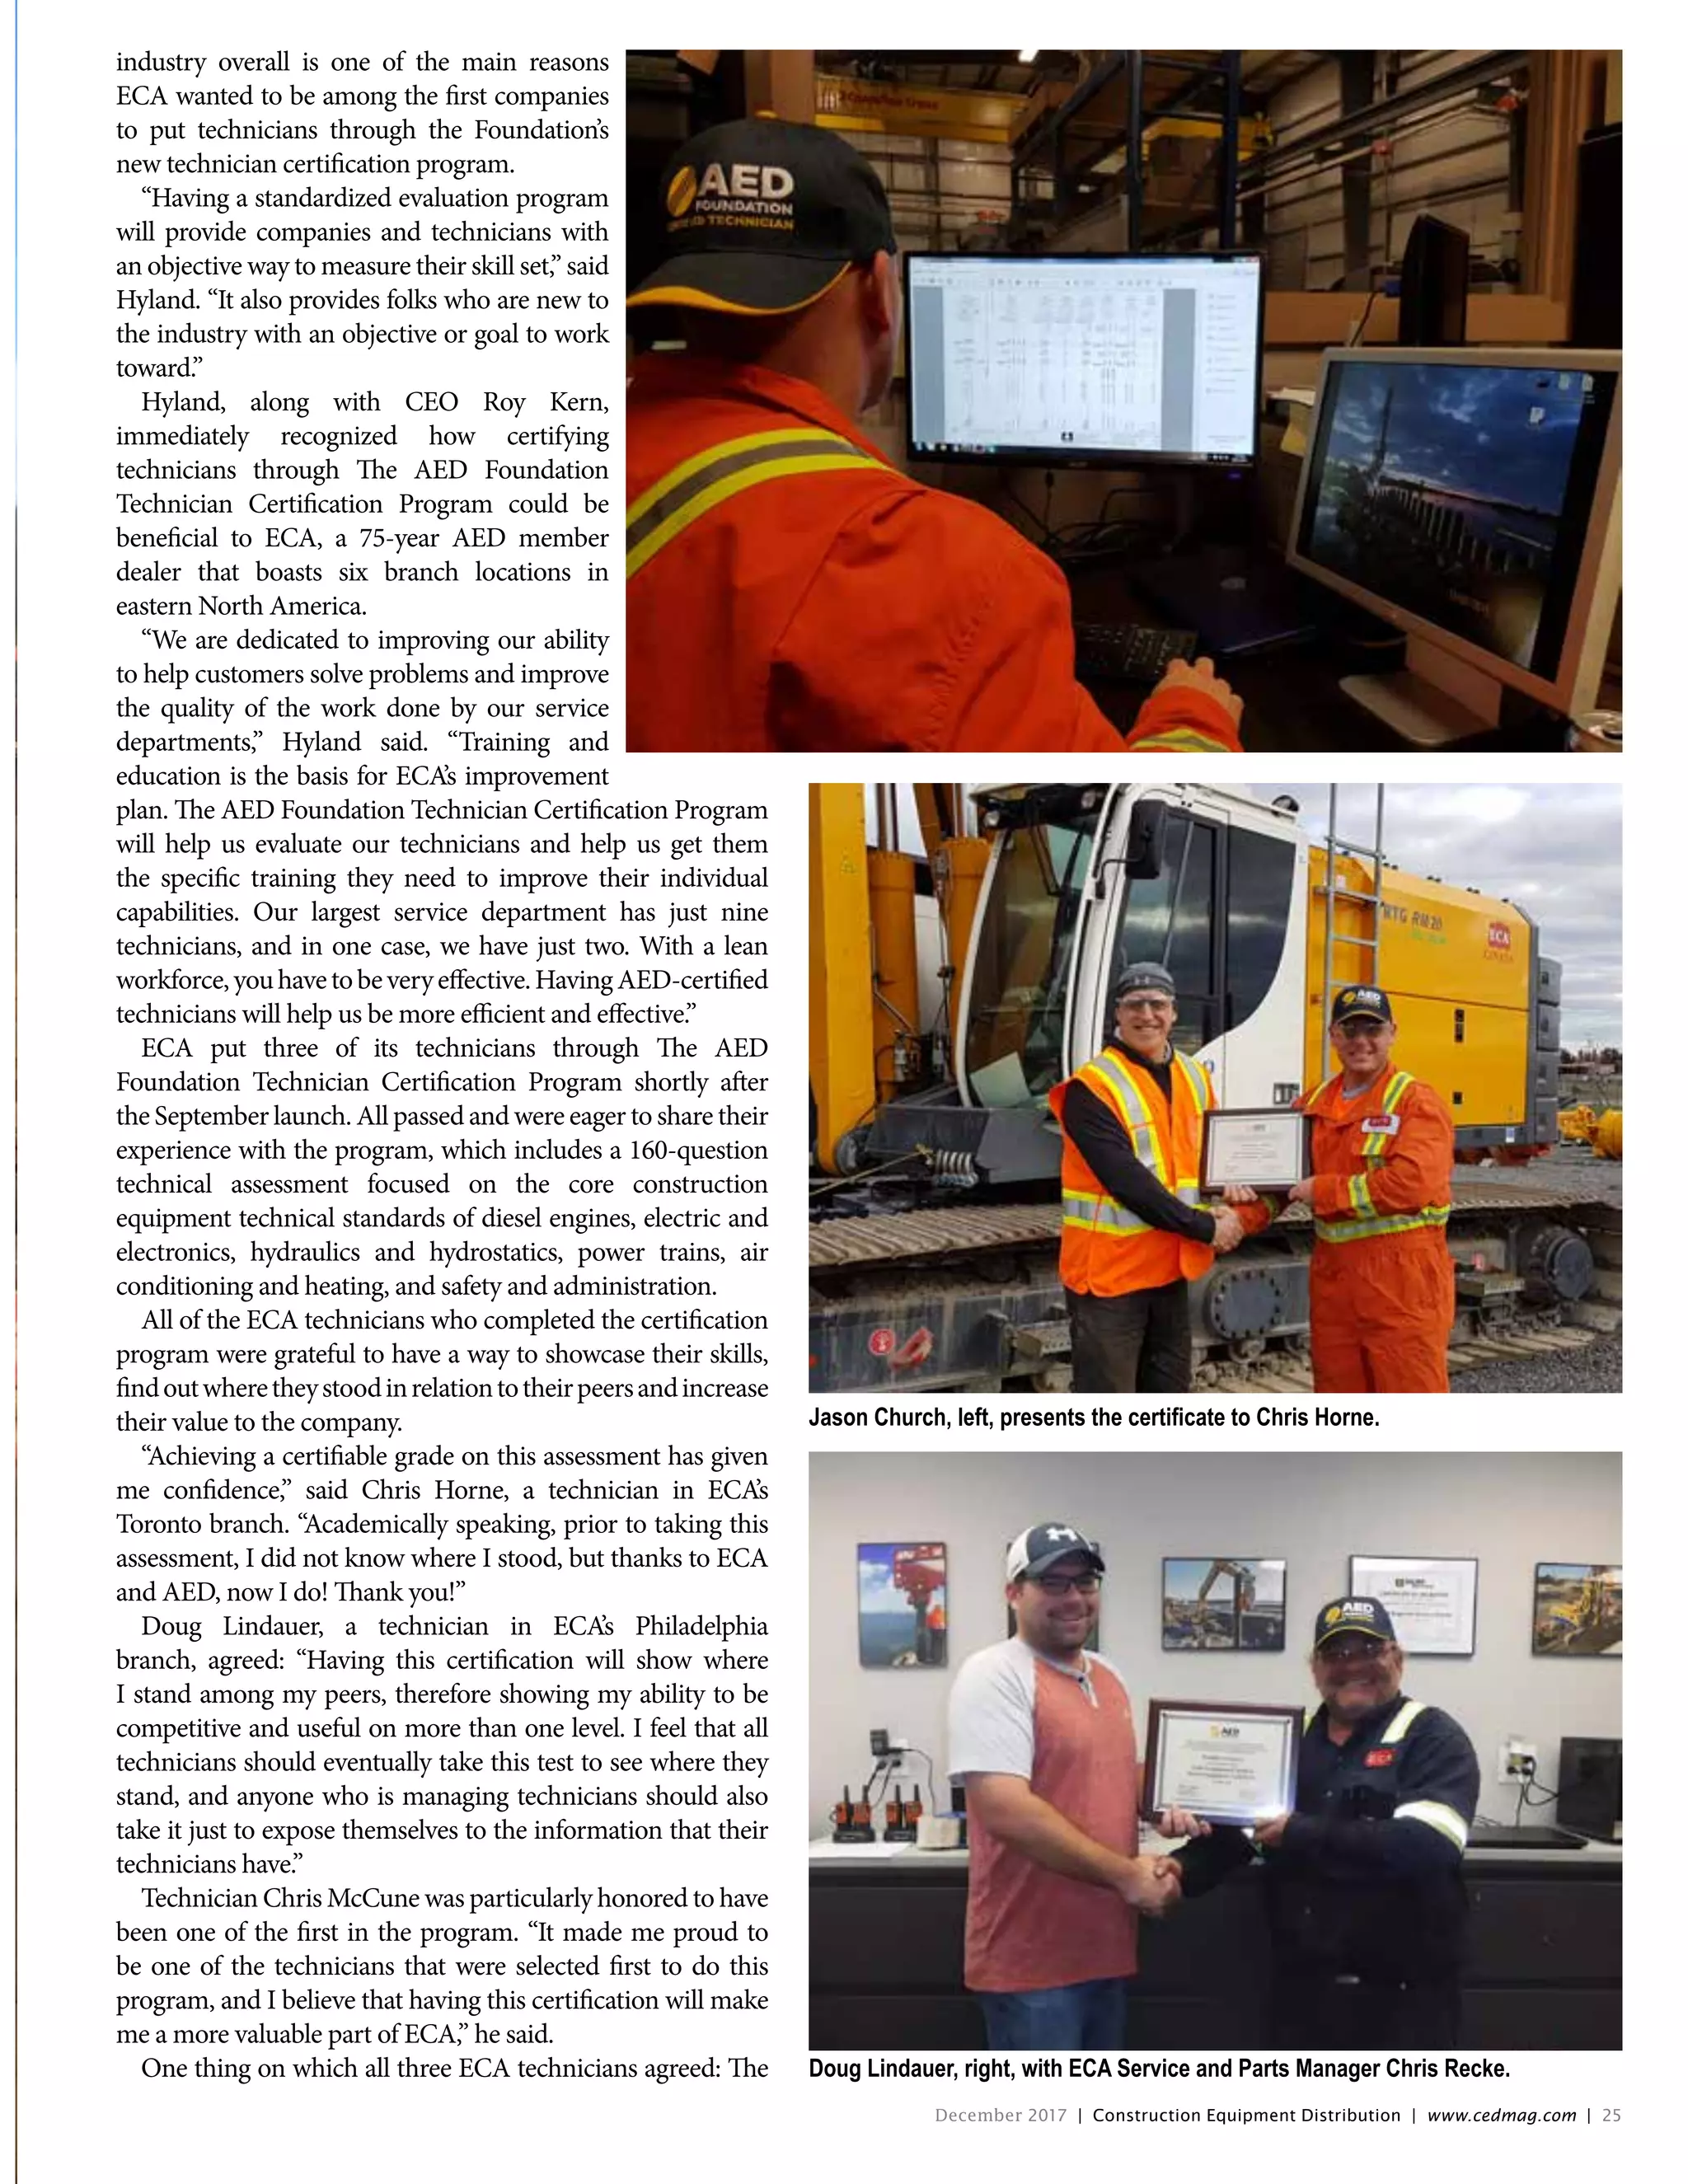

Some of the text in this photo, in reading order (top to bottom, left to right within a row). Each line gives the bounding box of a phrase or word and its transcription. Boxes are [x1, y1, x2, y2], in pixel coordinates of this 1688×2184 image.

[116, 49, 609, 78] industry overall is one of the main reasons
[697, 163, 795, 199] AED
[696, 199, 794, 215] FOUNDATION
[707, 214, 795, 231] TECHNICIAN
[141, 390, 609, 419] Hyland, along with CEO Roy Kern,
[115, 492, 609, 521] Technician Certification Program could be
[115, 526, 610, 555] beneficial to ECA, a 75-year AED member
[115, 662, 610, 690] to help customers solve problems and improve
[115, 798, 769, 827] plan. The AED Foundation Technician Certification Program
[116, 900, 769, 929] capabilities. Our largest service department has just nine
[1489, 928, 1510, 944] ECA
[116, 1070, 769, 1099] Foundation Technician Certification Program shortly after
[115, 1172, 769, 1194] technical assessment focused on the core construction
[116, 1240, 769, 1268] electronics, hydraulics and hydrostatics, power trains, air
[141, 1308, 769, 1336] All of the ECA technicians who completed the certification
[809, 1406, 1380, 1432] Jason Church, left, presents the certificate to Chris Horne.
[141, 1614, 769, 1643] Doug Lindauer, a technician in ECA’s Philadelphia
[116, 1784, 768, 1813] stand, and anyone who is managing technicians should also
[141, 1886, 769, 1915] Technician Chris McCune was particularly honored to have
[141, 2056, 769, 2085] One thing on which all three ECA technicians agreed: The
[809, 2057, 1510, 2083] Doug Lindauer, right, with ECA Service and Parts Manager Chris Recke.
[935, 2107, 1621, 2125] December 2017 Construction Equipment Distribution www.cedmag.com 25
